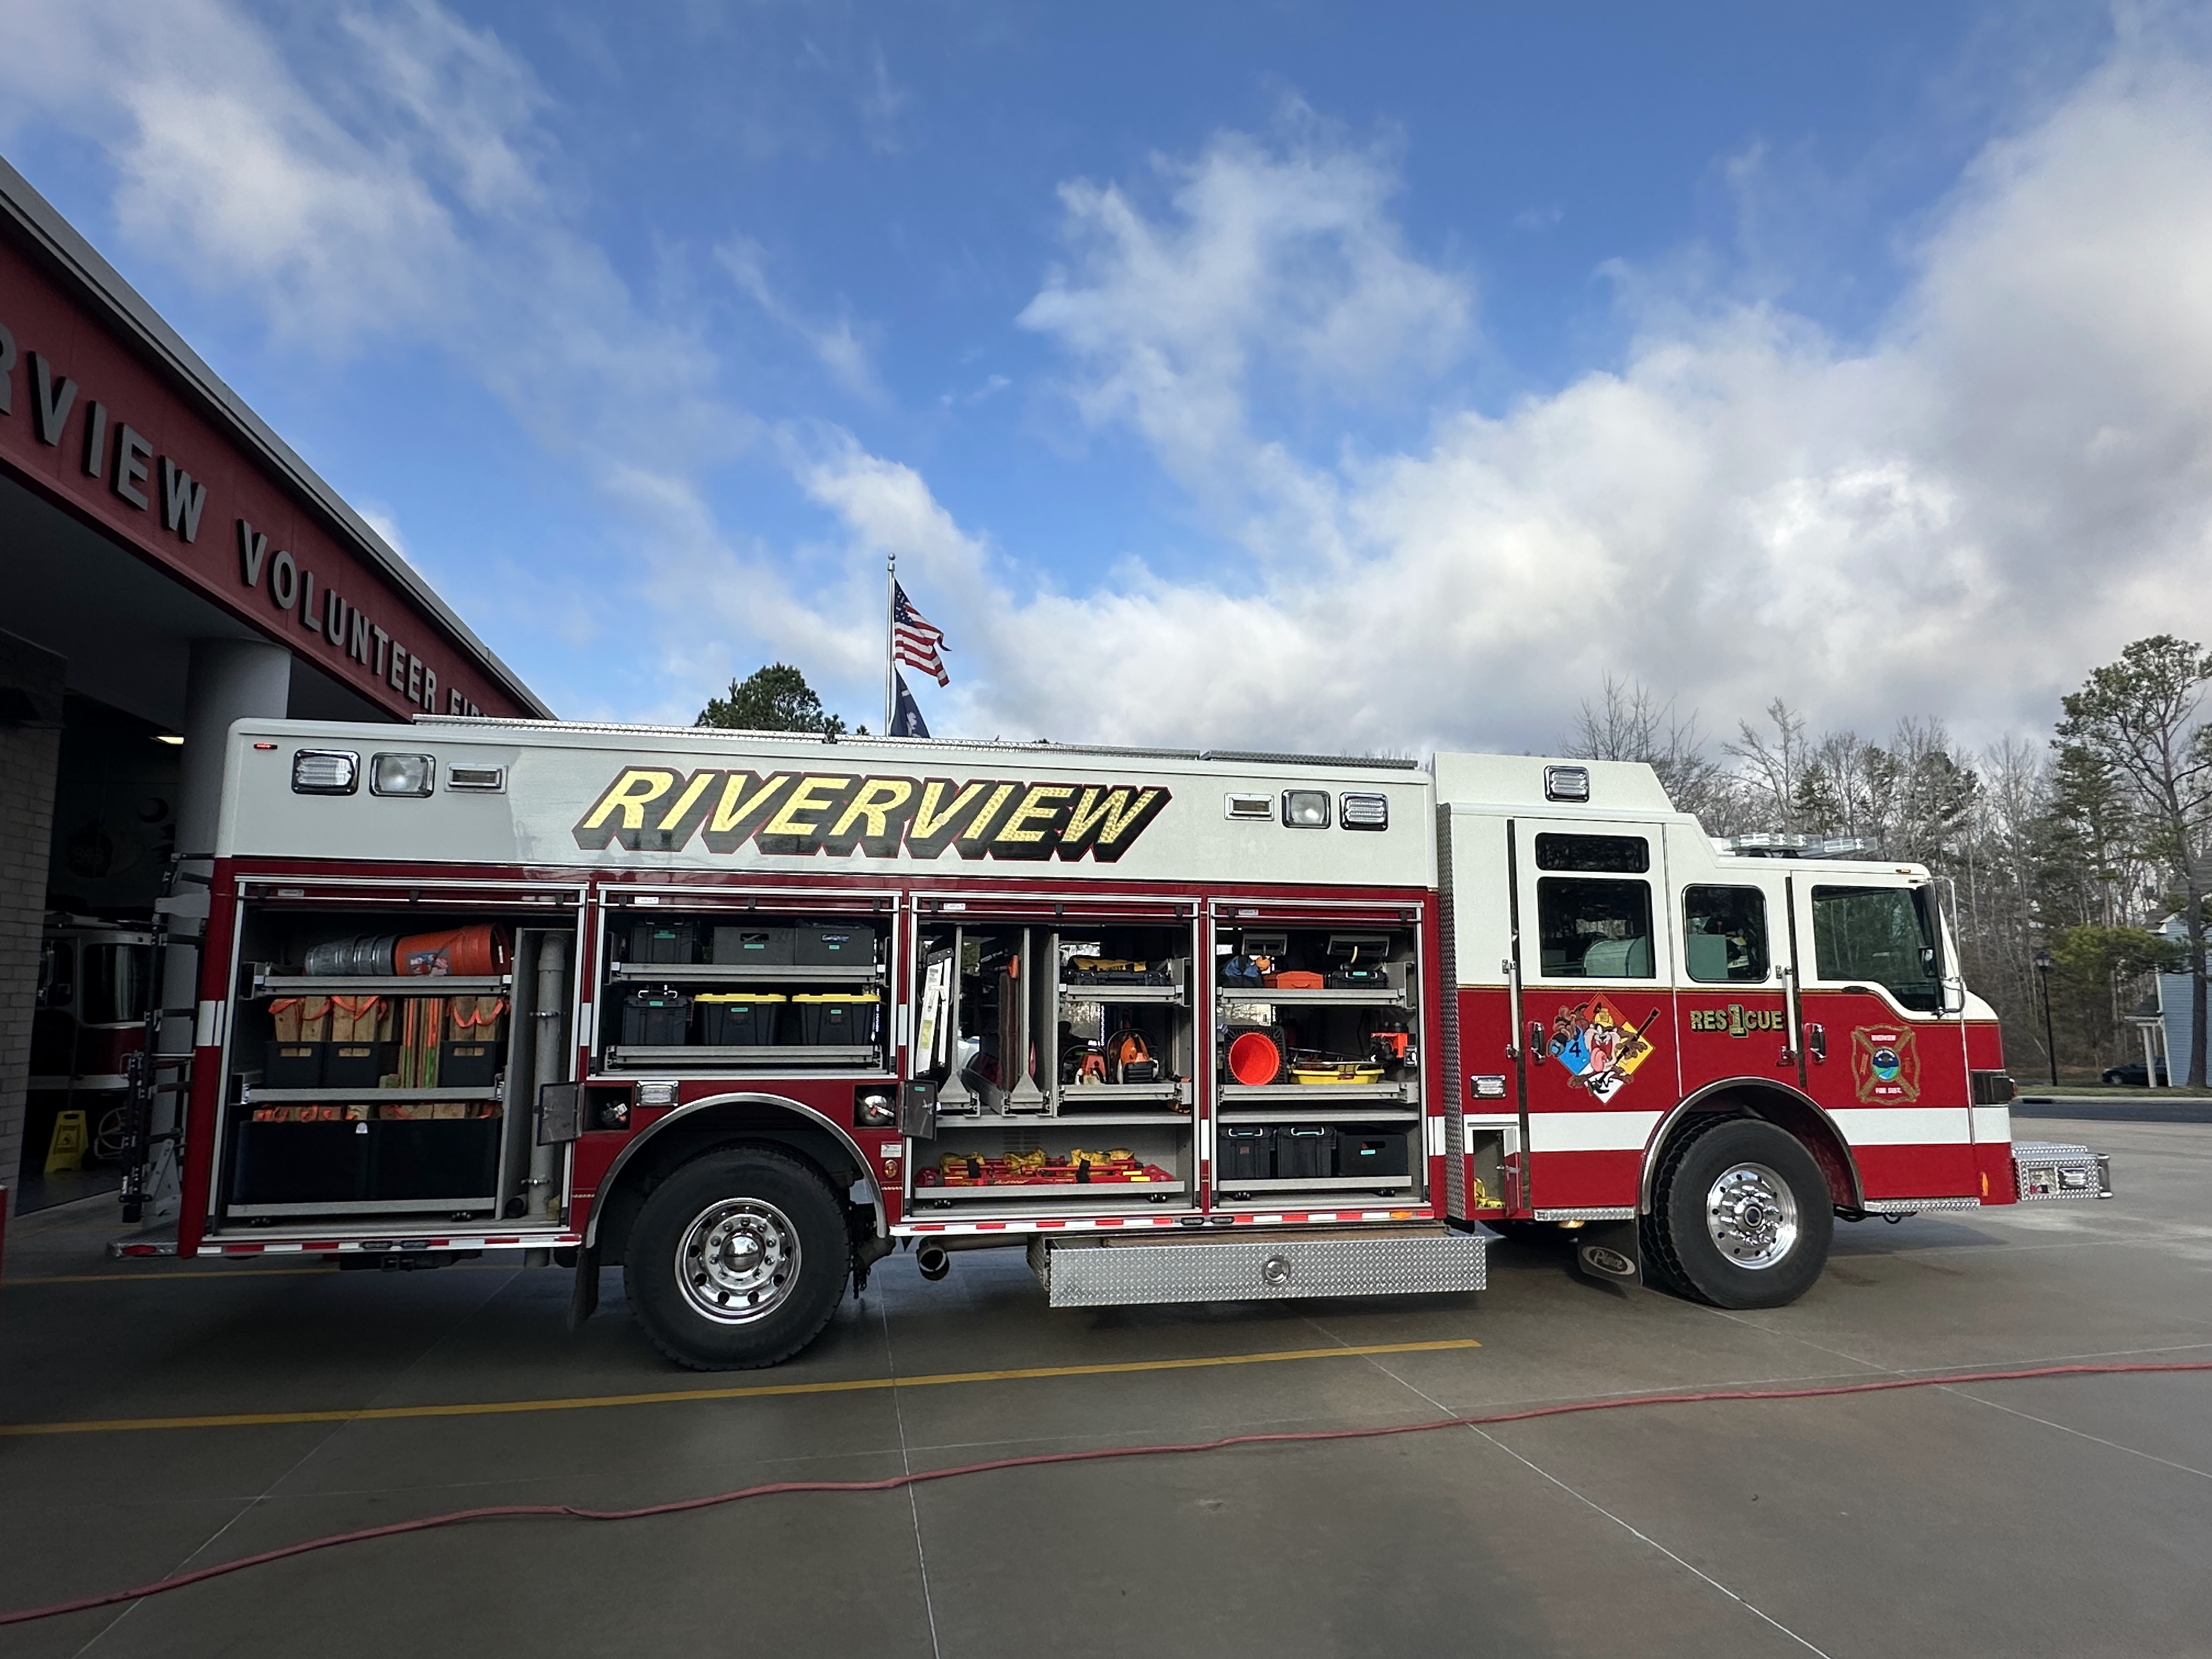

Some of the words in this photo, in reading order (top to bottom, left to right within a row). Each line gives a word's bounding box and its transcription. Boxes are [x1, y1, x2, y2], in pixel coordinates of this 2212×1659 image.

[238, 518, 438, 713] VOLUNTEER
[448, 687, 488, 717] FI
[573, 765, 1172, 863] RIVERVIEW
[1569, 1041, 1581, 1058] 4
